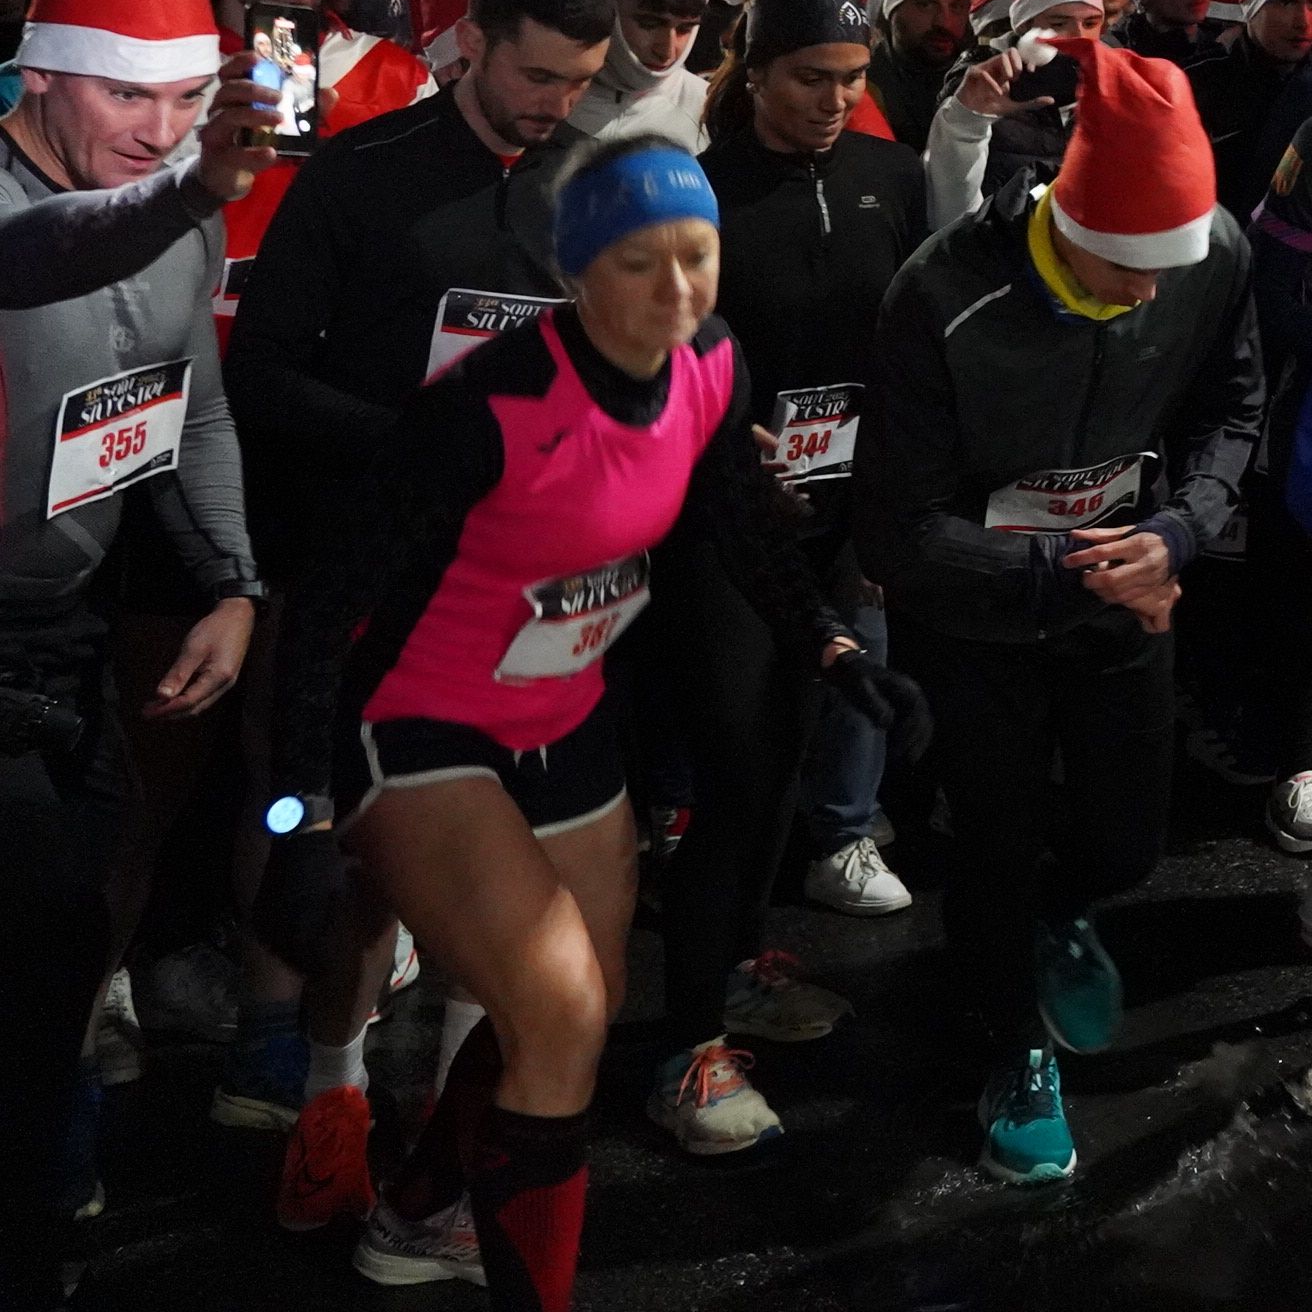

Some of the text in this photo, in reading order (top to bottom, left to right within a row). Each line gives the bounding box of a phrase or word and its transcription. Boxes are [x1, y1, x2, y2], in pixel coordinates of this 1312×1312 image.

[99, 421, 148, 468] 355
[787, 430, 832, 462] 344
[1047, 491, 1105, 518] 346
